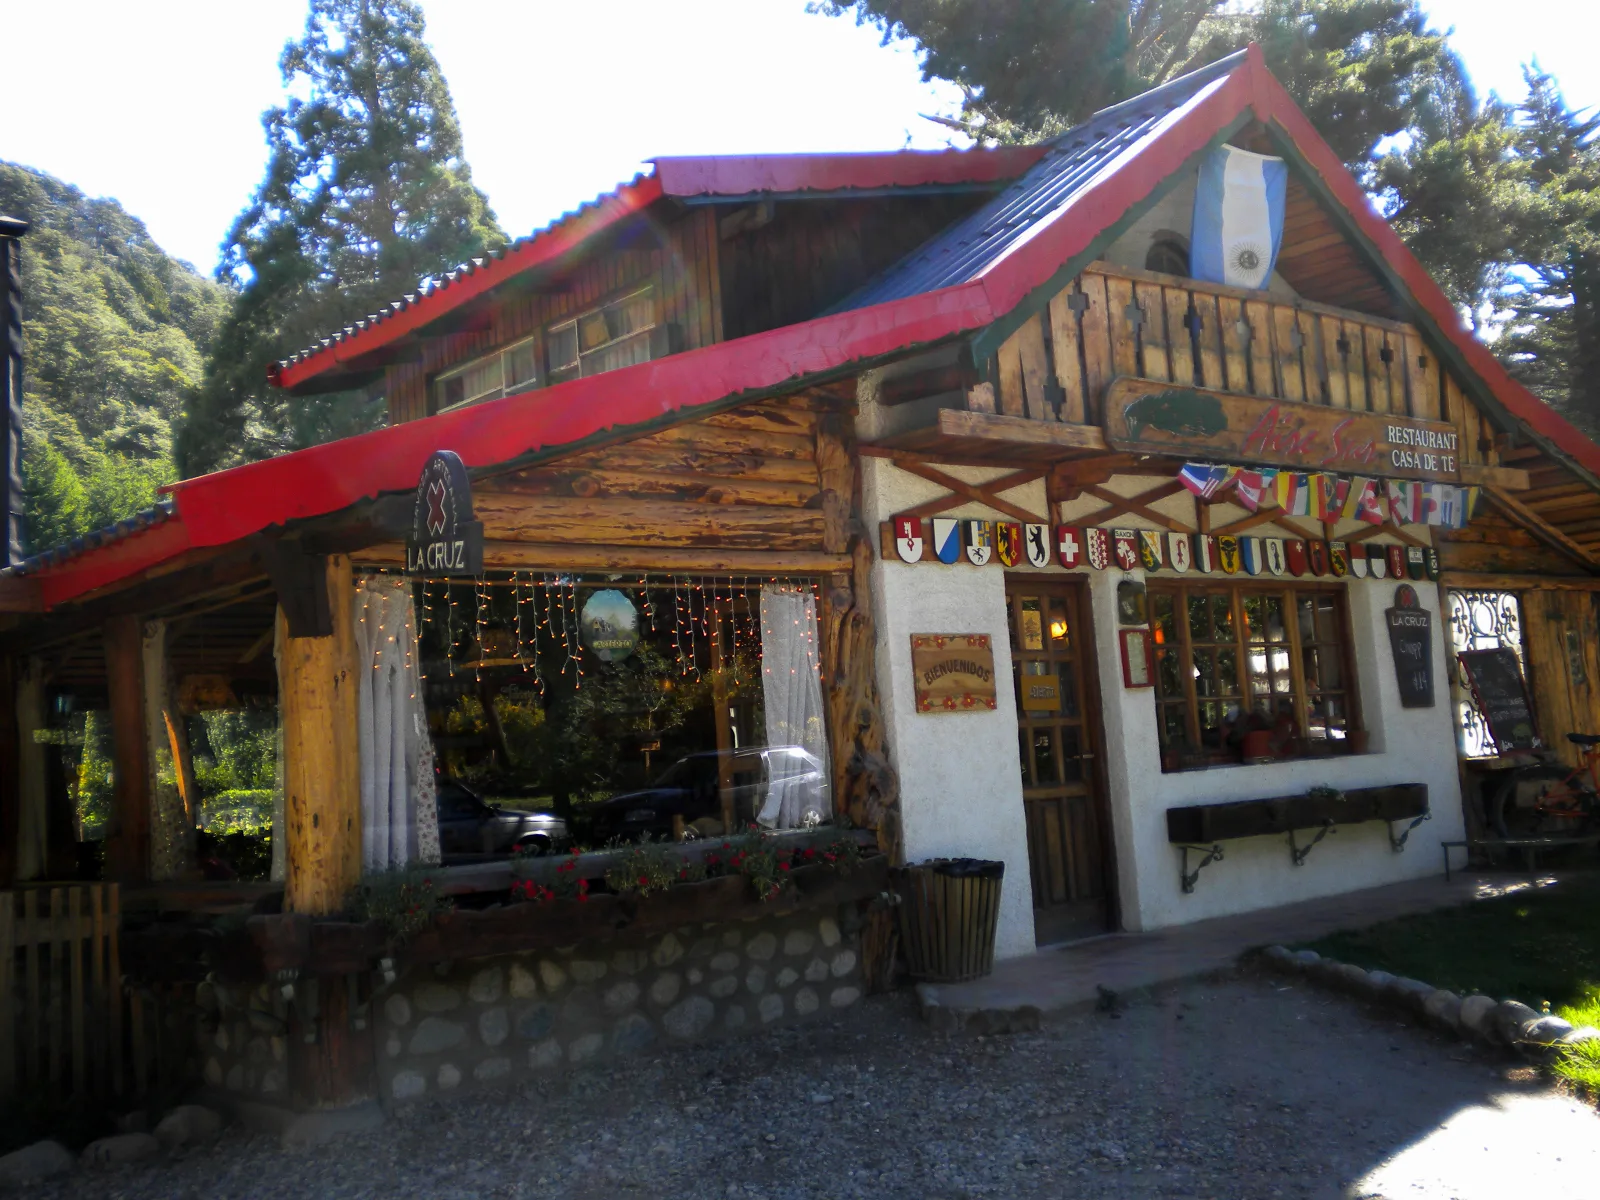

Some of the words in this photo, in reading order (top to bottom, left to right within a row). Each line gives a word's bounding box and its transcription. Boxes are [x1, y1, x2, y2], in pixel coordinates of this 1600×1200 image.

[1240, 402, 1318, 456] Aire
[1321, 417, 1378, 465] Sur
[1388, 425, 1457, 450] RESTAURANT
[1391, 449, 1421, 469] CASA
[1424, 453, 1438, 471] DE
[1441, 456, 1455, 472] TE
[1115, 530, 1135, 538] SAXON
[408, 547, 425, 572] LA
[427, 540, 464, 570] CRUZ
[1392, 616, 1404, 626] LA
[1404, 616, 1428, 627] CRUZ
[923, 659, 990, 686] BIENVENIDOS
